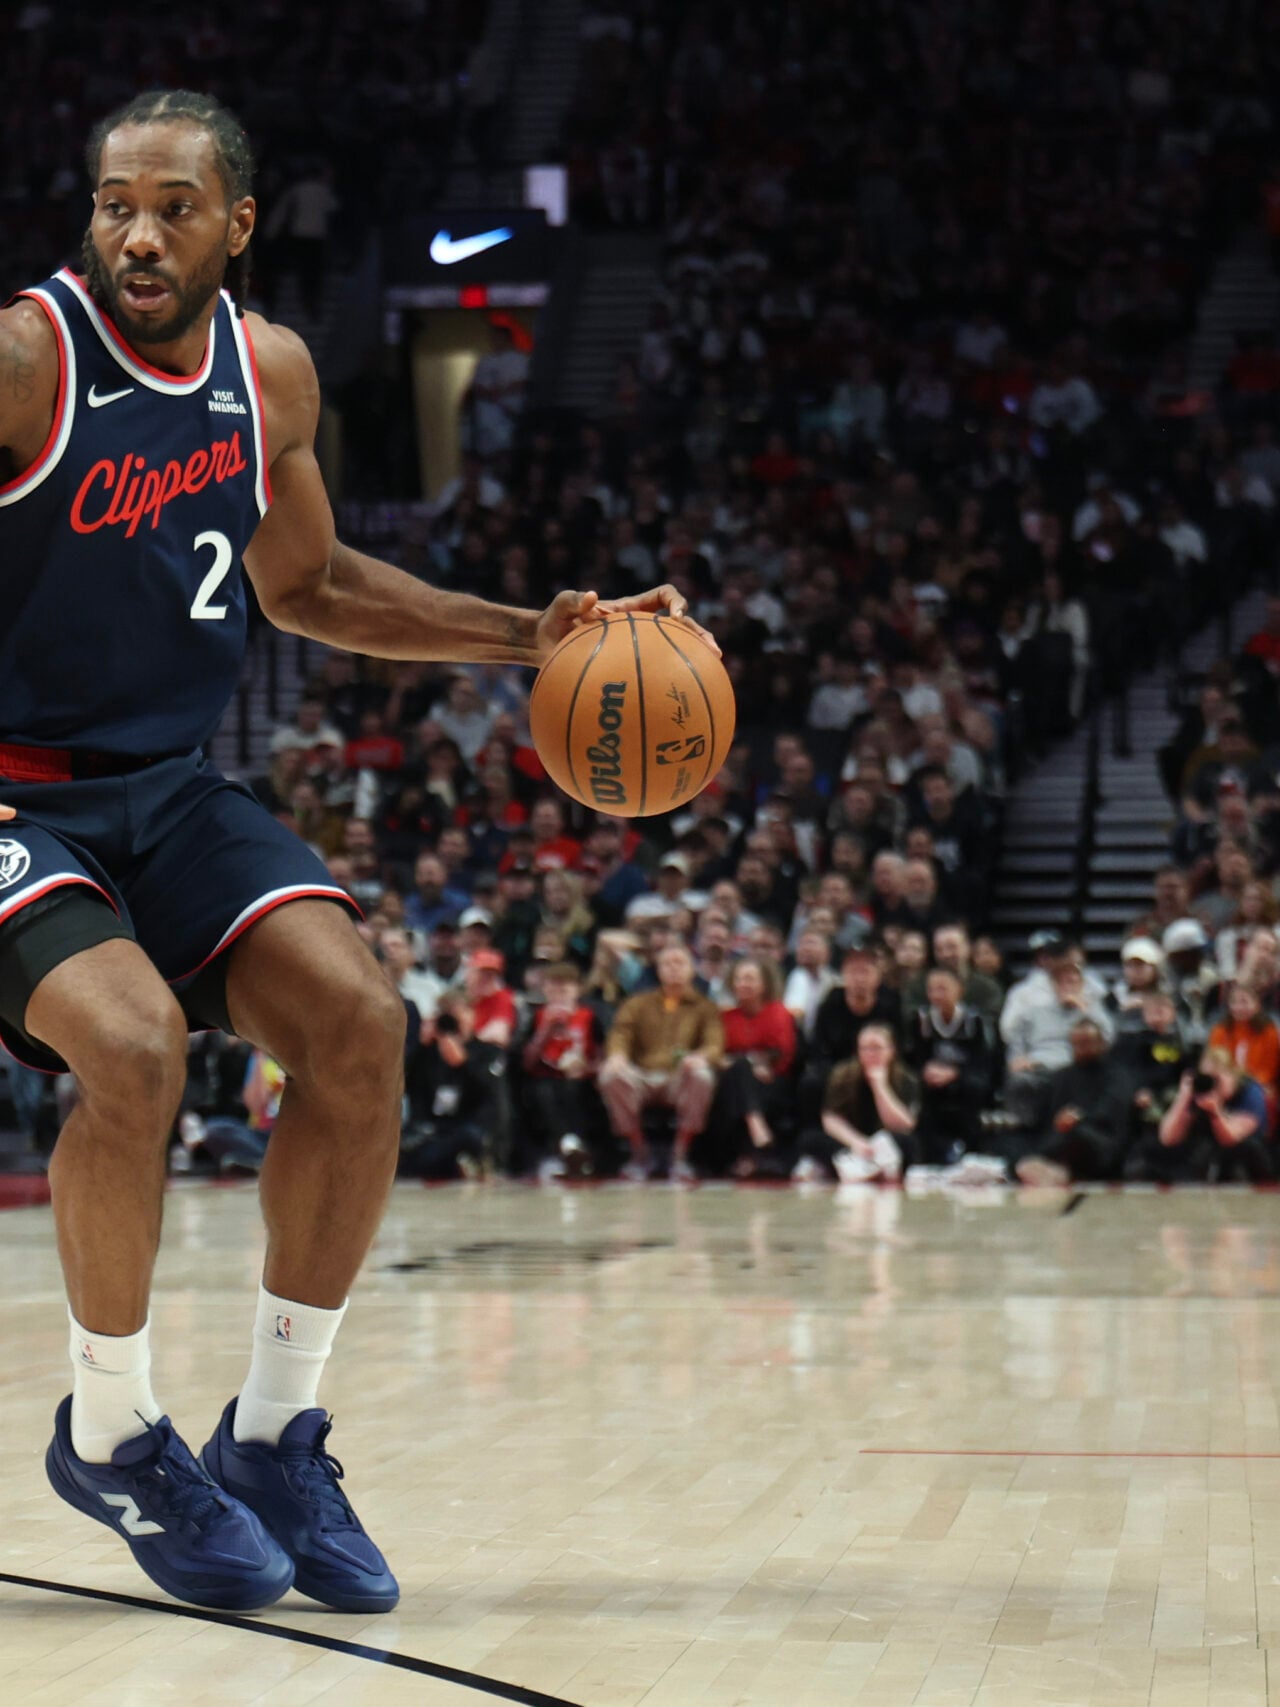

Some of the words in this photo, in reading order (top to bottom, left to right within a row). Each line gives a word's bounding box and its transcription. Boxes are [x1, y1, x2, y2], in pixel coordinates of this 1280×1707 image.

[208, 401, 247, 414] RWANDA
[212, 390, 234, 402] VISIT
[70, 431, 247, 539] Clippers
[190, 530, 233, 619] 2
[586, 680, 627, 805] Wilson
